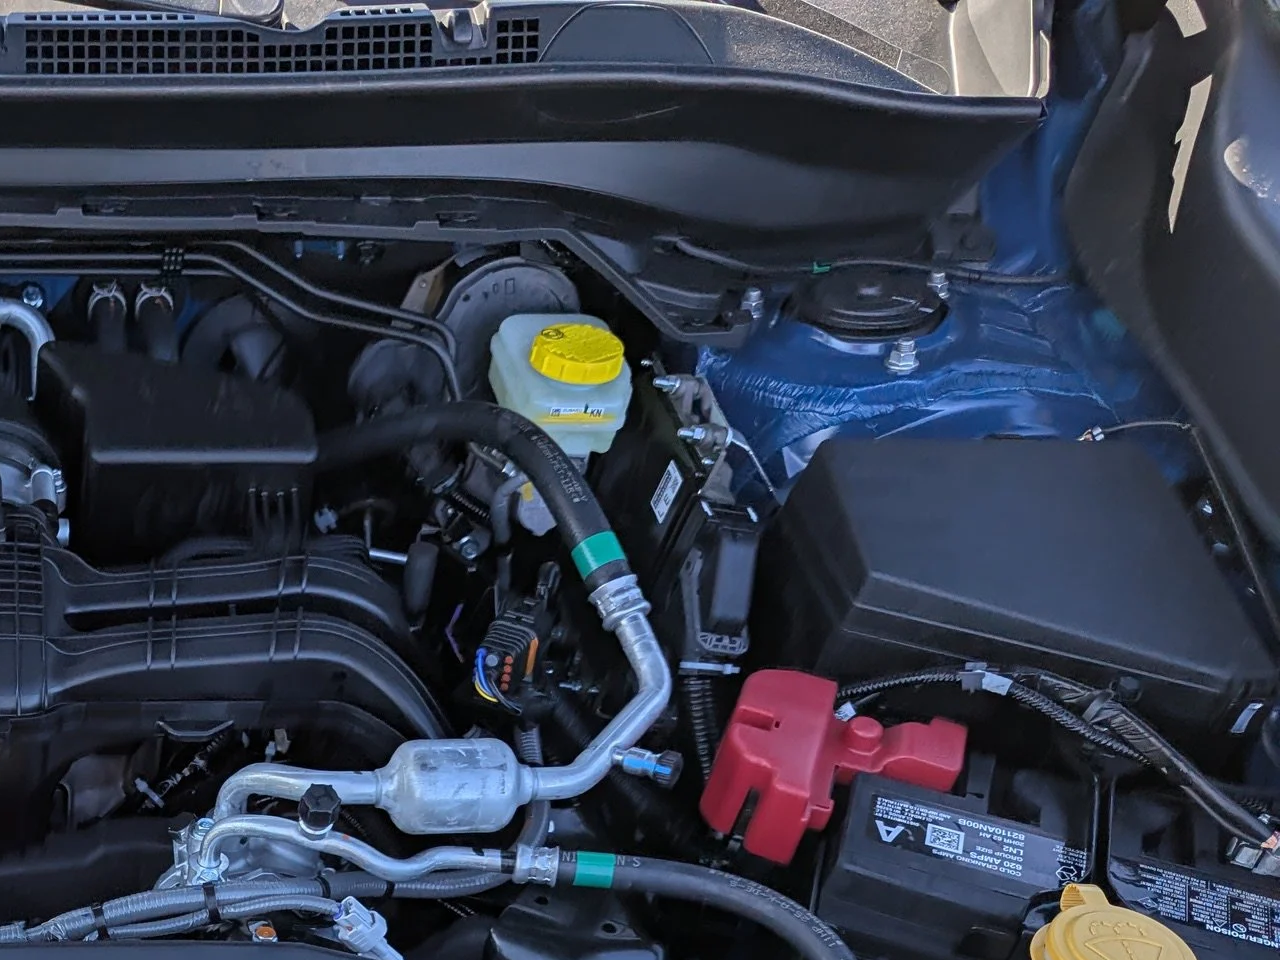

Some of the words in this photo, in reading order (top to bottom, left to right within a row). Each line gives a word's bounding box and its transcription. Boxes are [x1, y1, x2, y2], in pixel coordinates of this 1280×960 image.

[875, 820, 905, 843] A
[958, 818, 1025, 841] 82110AN00B
[1003, 838, 1025, 847] 20HR
[932, 848, 955, 859] AMPS
[975, 845, 993, 854] SIZE
[1002, 844, 1024, 856] LN2
[969, 851, 1002, 865] AMPS
[994, 851, 1024, 862] GROUP
[956, 855, 998, 870] CRANKING
[1003, 860, 1022, 871] 620
[999, 867, 1022, 877] COLD
[1205, 923, 1280, 948] NGER/POISON
